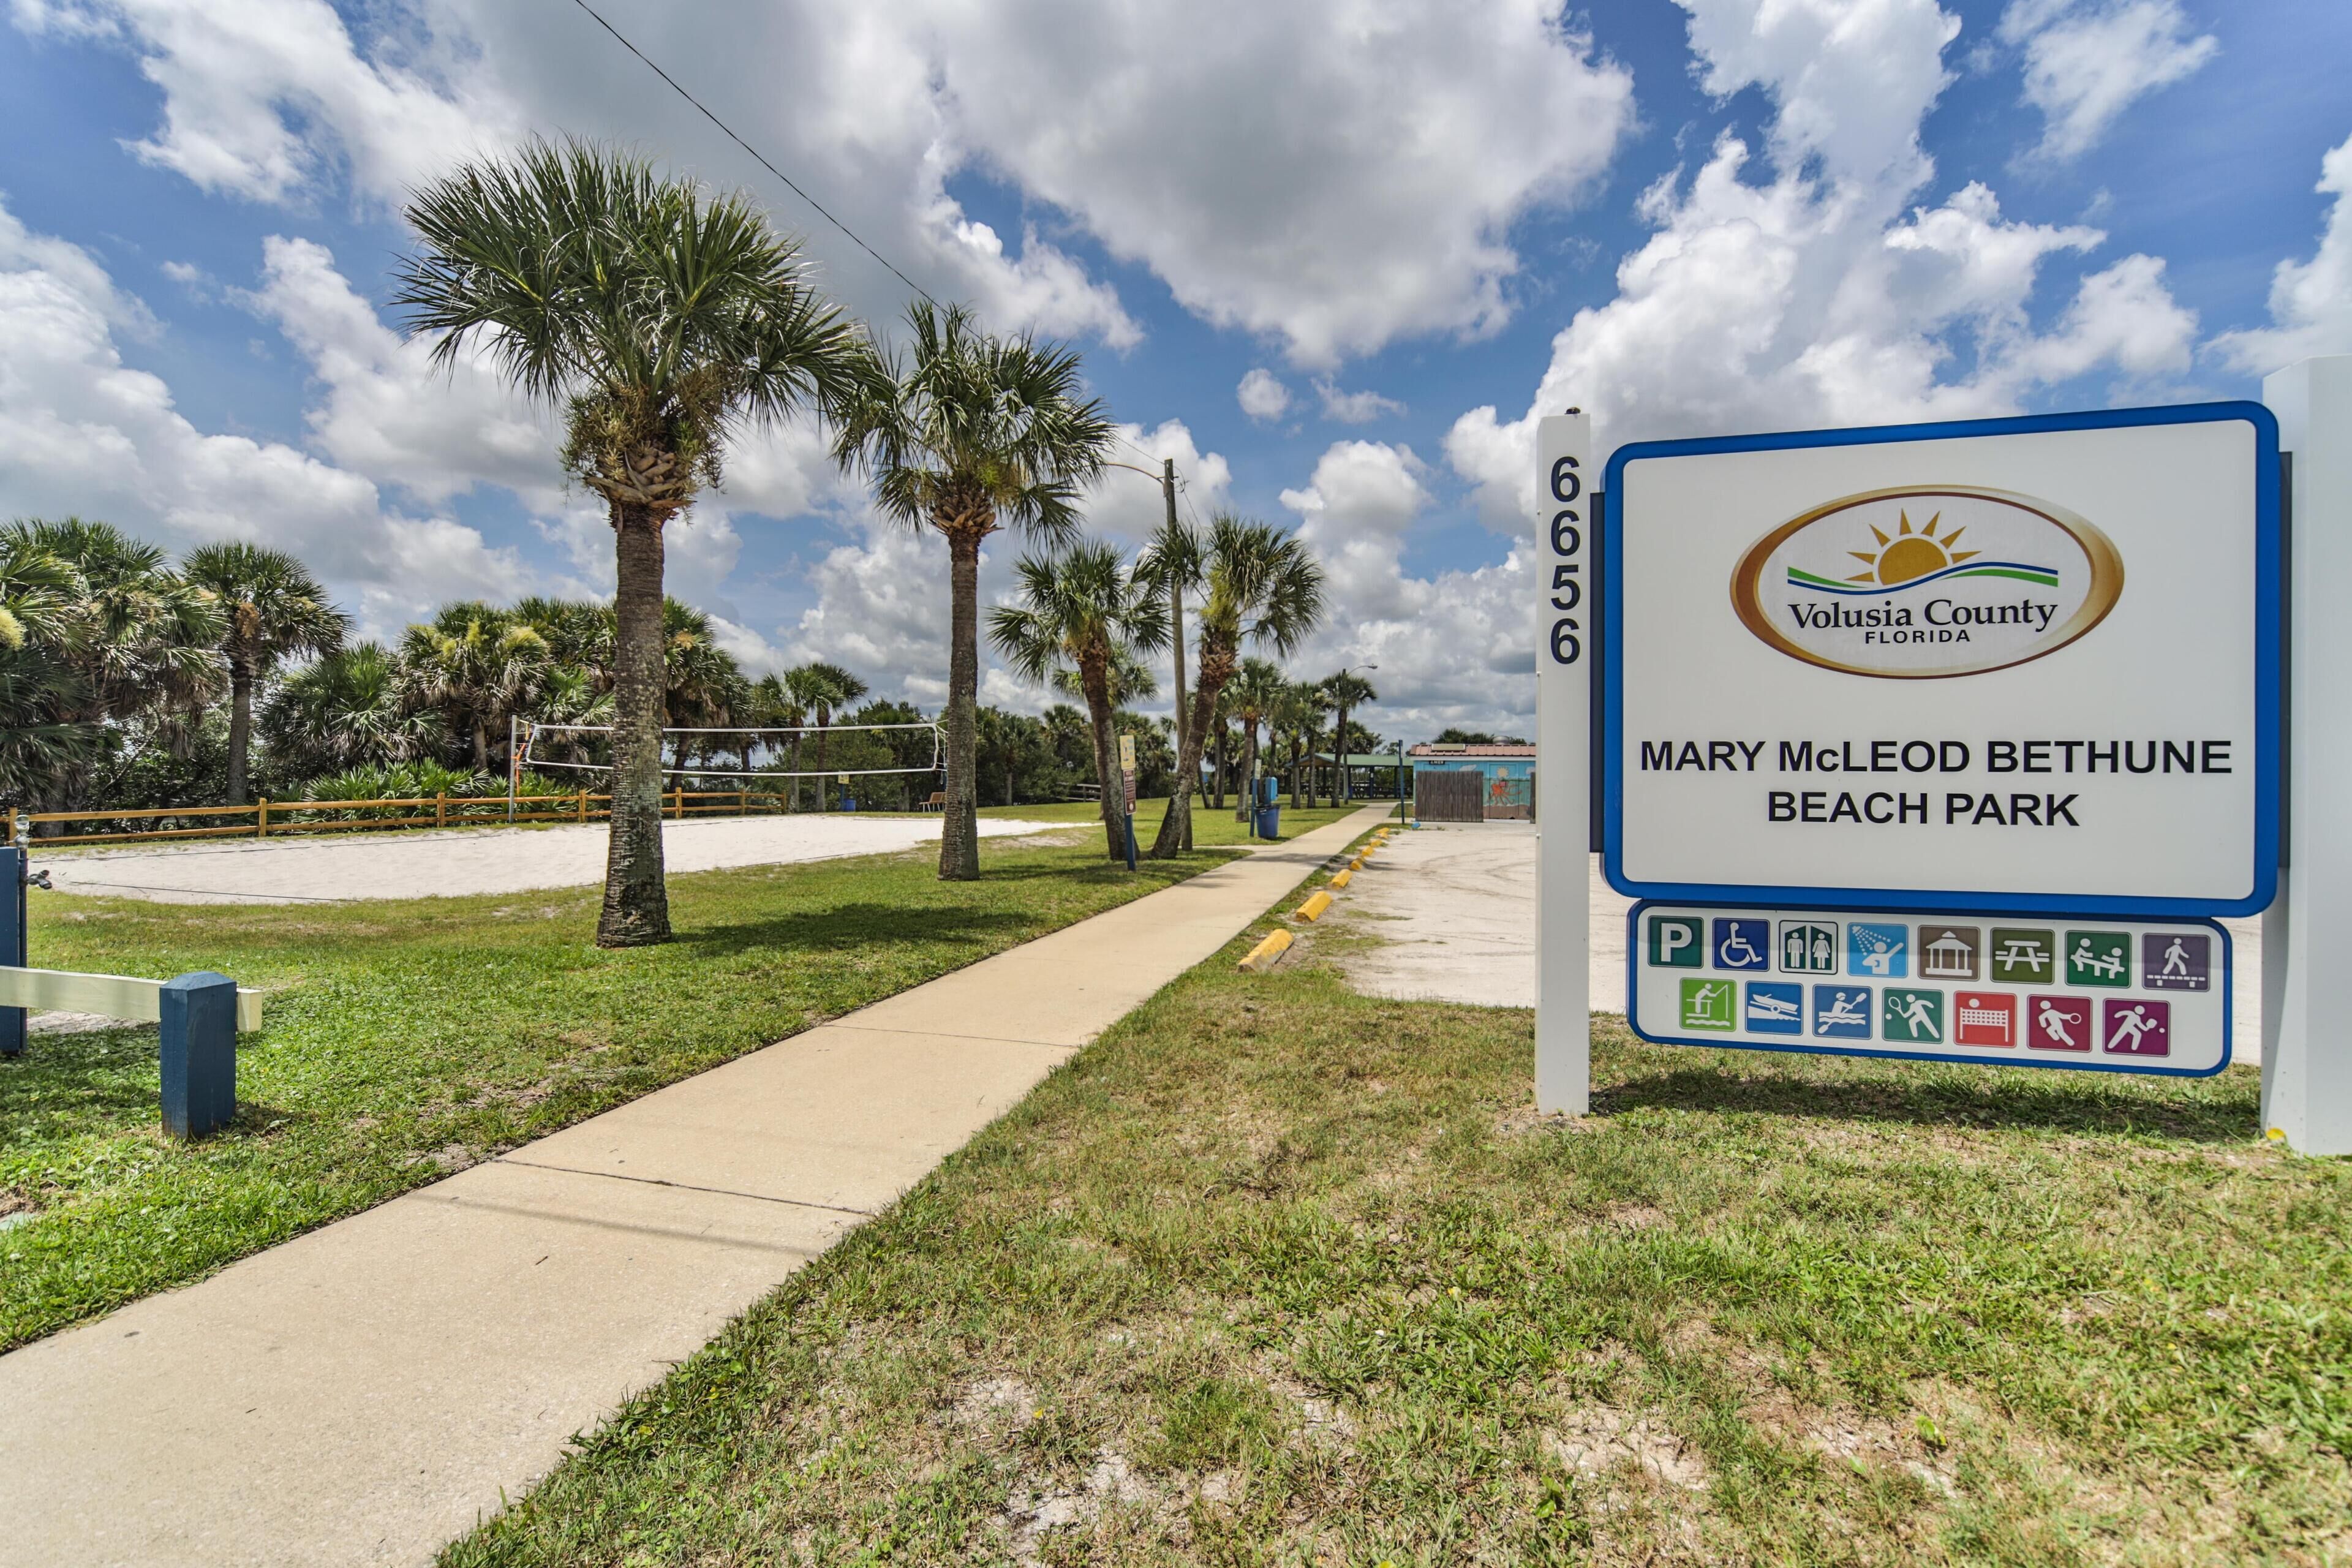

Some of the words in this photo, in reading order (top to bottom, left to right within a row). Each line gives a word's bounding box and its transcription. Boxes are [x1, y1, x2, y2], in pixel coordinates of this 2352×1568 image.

[1551, 456, 1580, 664] 6656
[1788, 601, 1913, 629] Volusia
[1924, 599, 2059, 633] County
[1866, 630, 1970, 644] FLORIDA
[1642, 741, 1766, 771] MARY
[1779, 741, 1969, 773] McLEOD
[1988, 741, 2232, 774] BETHUNE
[1768, 791, 1928, 824] BEACH
[1947, 793, 2080, 826] PARK
[1660, 922, 1692, 962] P
